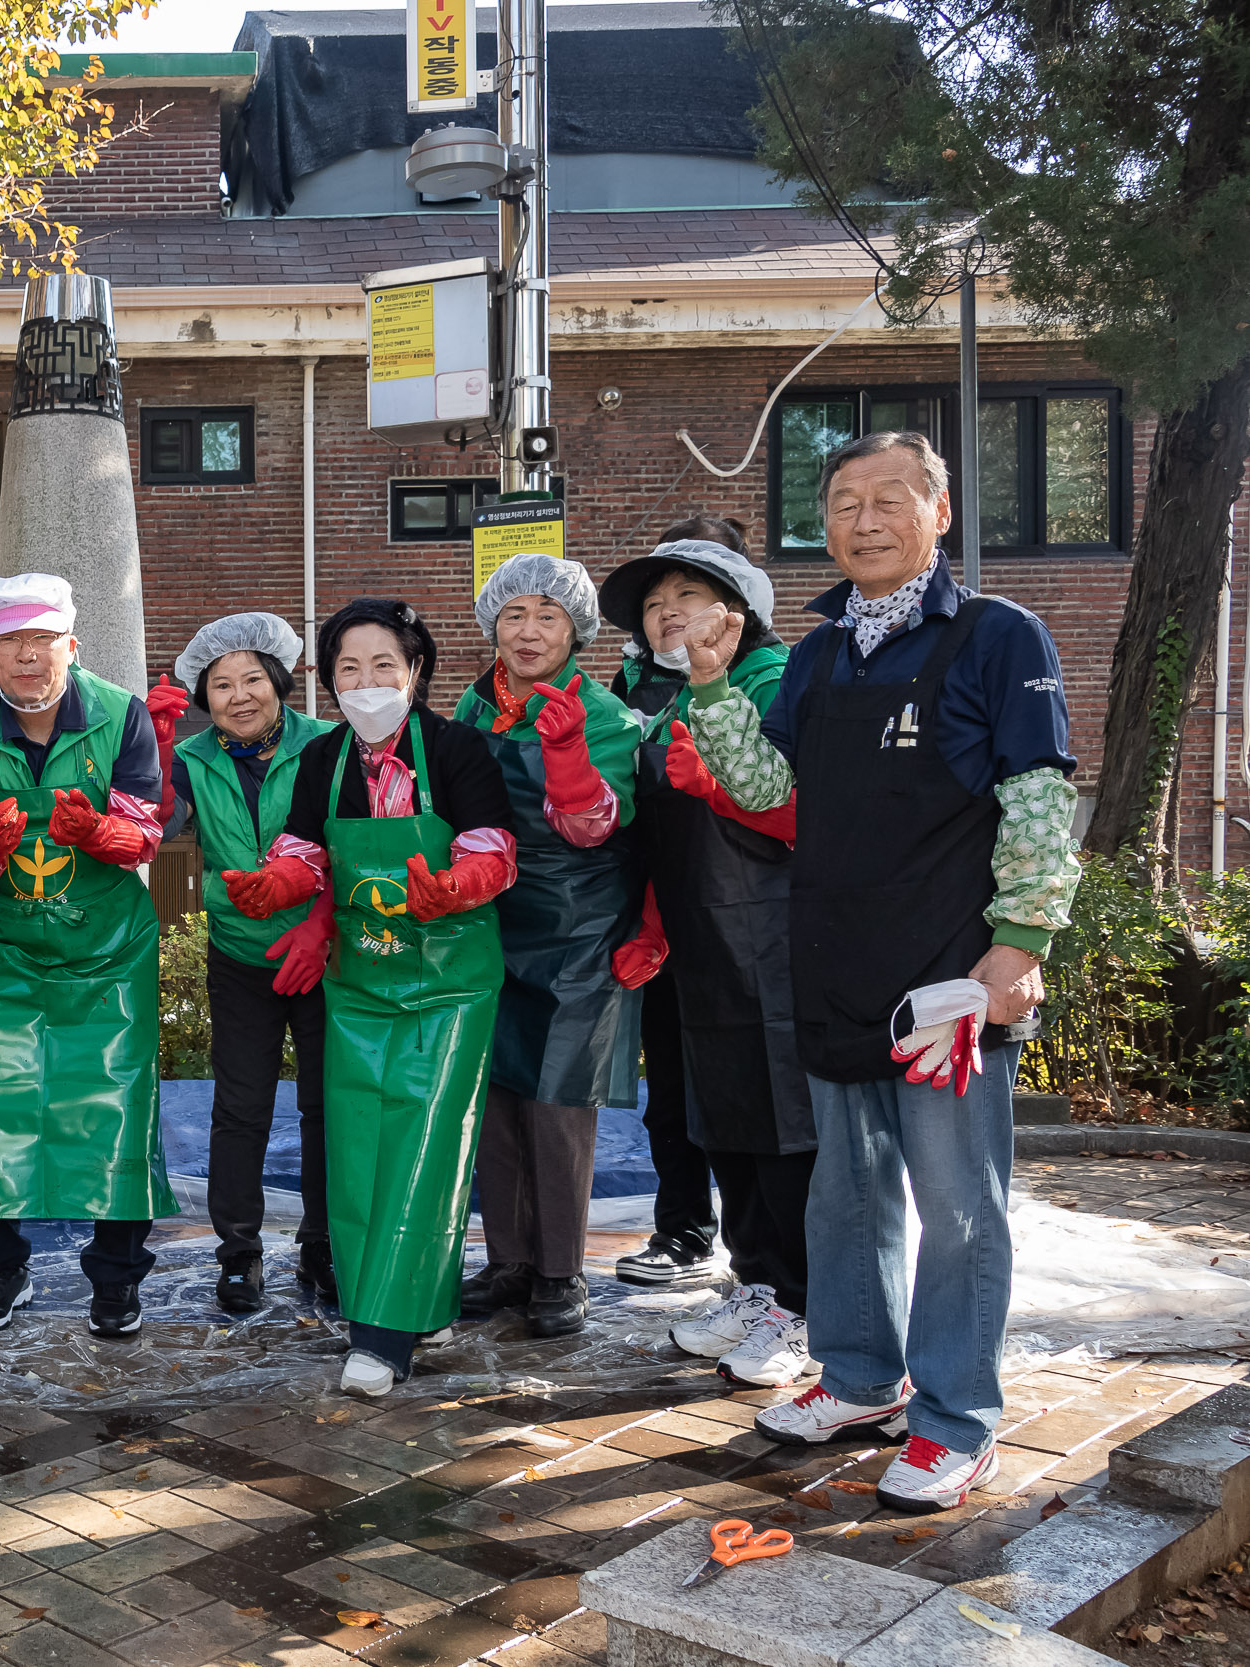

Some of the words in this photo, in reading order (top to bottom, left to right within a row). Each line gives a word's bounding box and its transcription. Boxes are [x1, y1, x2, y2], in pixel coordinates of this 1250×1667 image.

[487, 510, 535, 521] 영상정보처리기기
[536, 507, 560, 516] 설치안내
[1023, 678, 1040, 688] 2022
